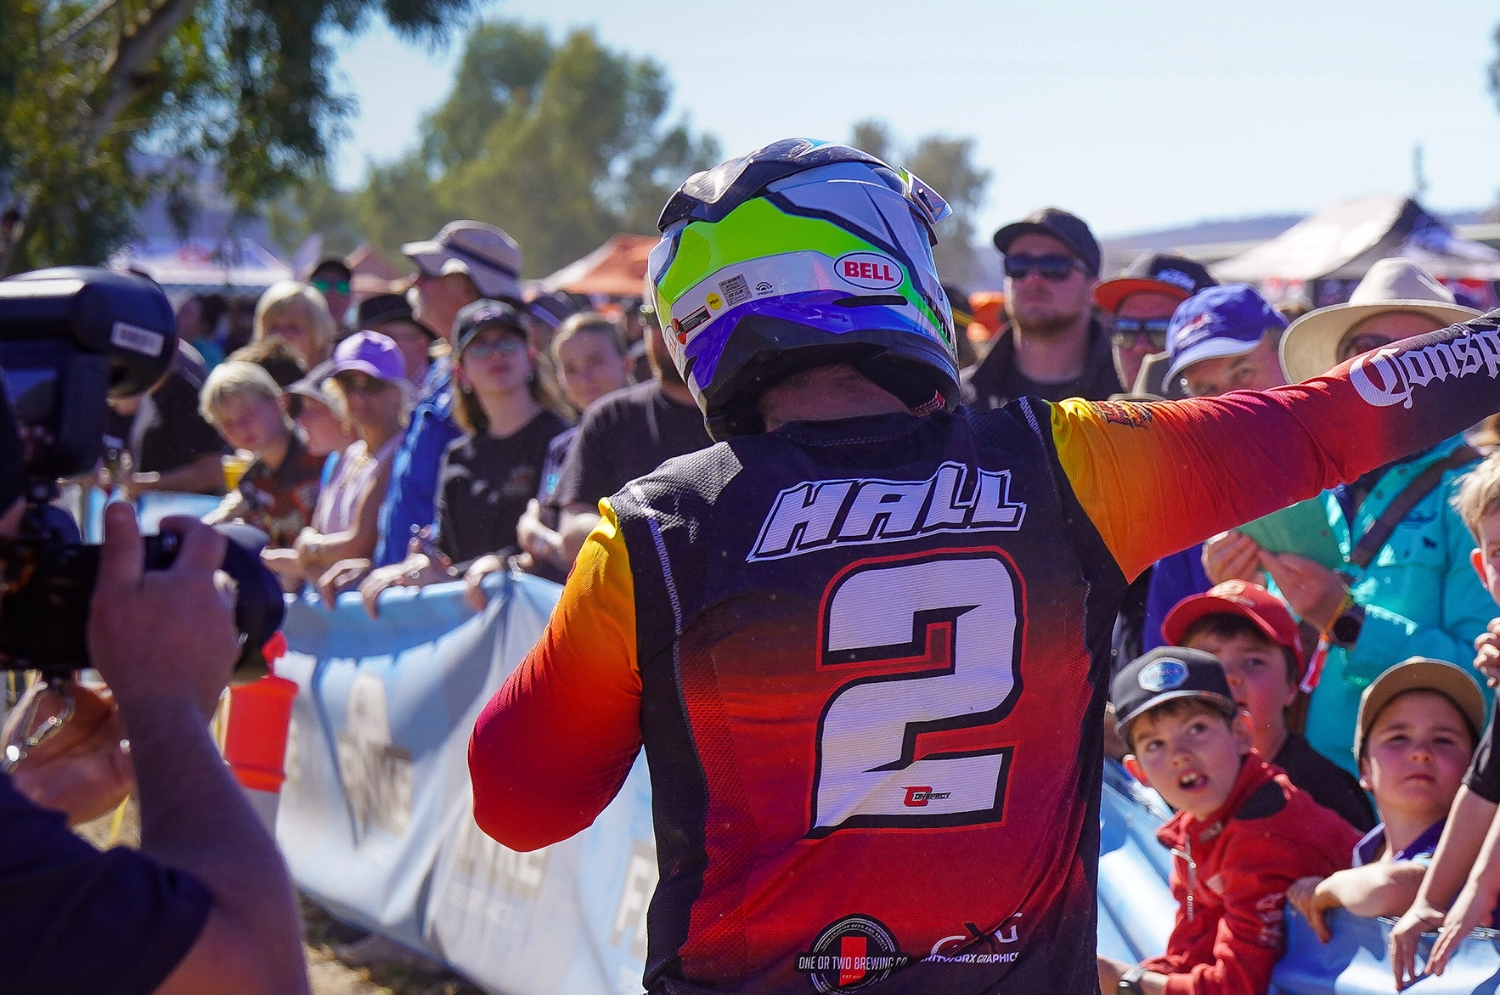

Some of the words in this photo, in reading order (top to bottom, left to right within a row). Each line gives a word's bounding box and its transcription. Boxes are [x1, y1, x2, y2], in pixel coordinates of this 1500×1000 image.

[844, 260, 895, 282] BELL
[747, 462, 1026, 562] HALL
[809, 551, 1022, 835] 2
[798, 955, 816, 970] ONE
[817, 955, 830, 970] OR
[832, 955, 852, 970] TWO
[854, 955, 893, 970] BREWING
